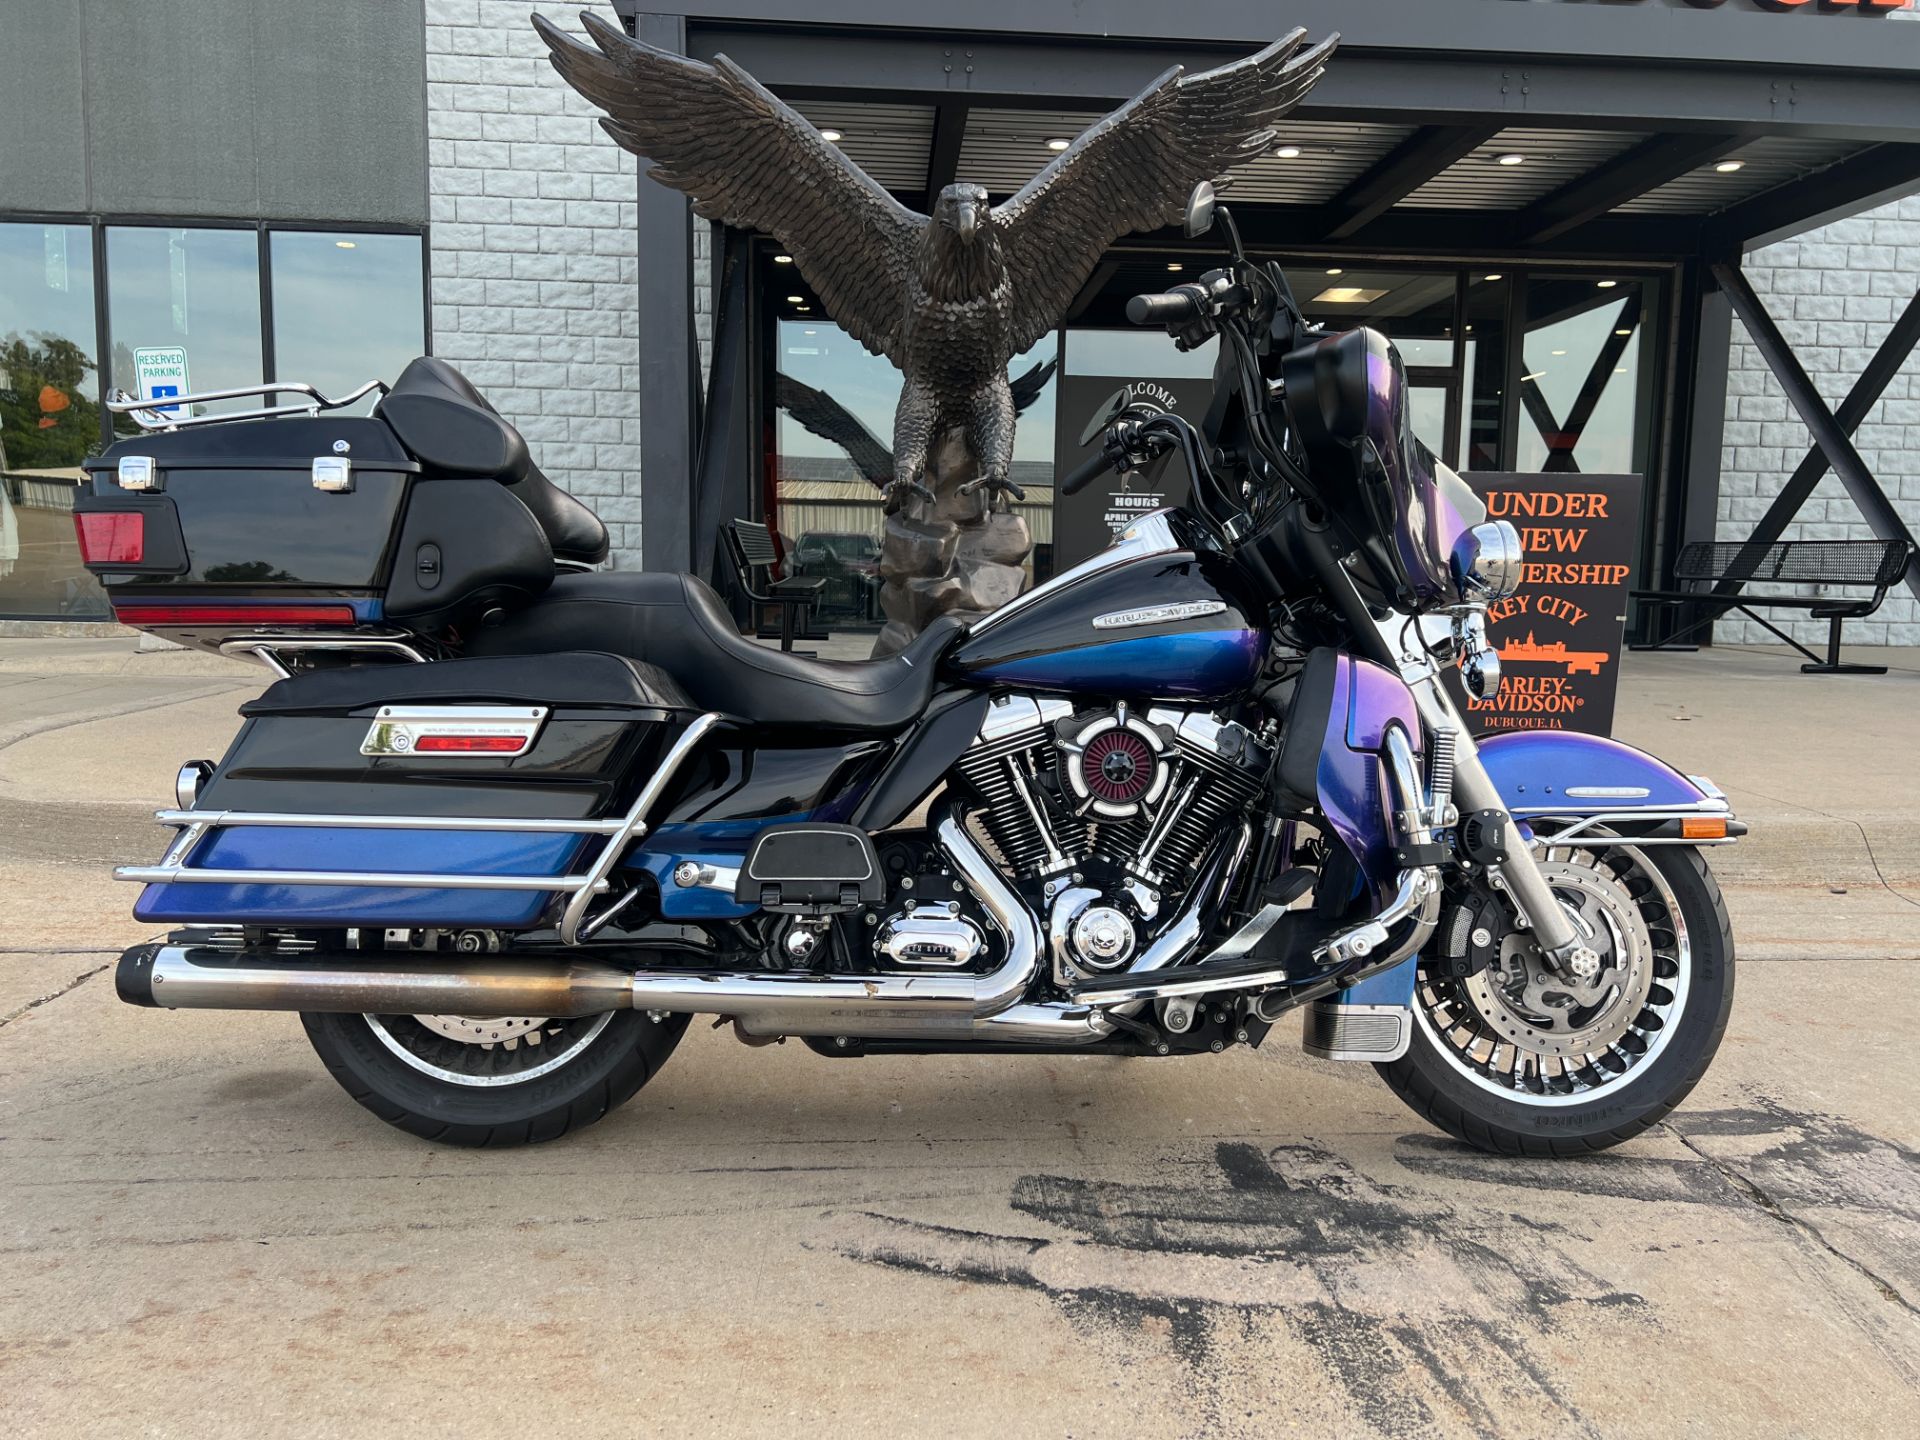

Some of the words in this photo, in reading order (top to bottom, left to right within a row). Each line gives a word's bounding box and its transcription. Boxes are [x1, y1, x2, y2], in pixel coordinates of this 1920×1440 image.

[139, 354, 183, 365] RESERVED
[143, 367, 182, 377] PARKING
[1128, 381, 1177, 410] LCOME
[1114, 497, 1160, 508] HOURS
[1485, 491, 1609, 518] UNDER
[1103, 513, 1129, 522] APRIL
[1519, 563, 1630, 585] ERSHIP
[1487, 594, 1532, 625] KEY
[1536, 595, 1589, 627] CITY
[1500, 676, 1573, 695] ARLEY-
[1549, 717, 1563, 729] IA
